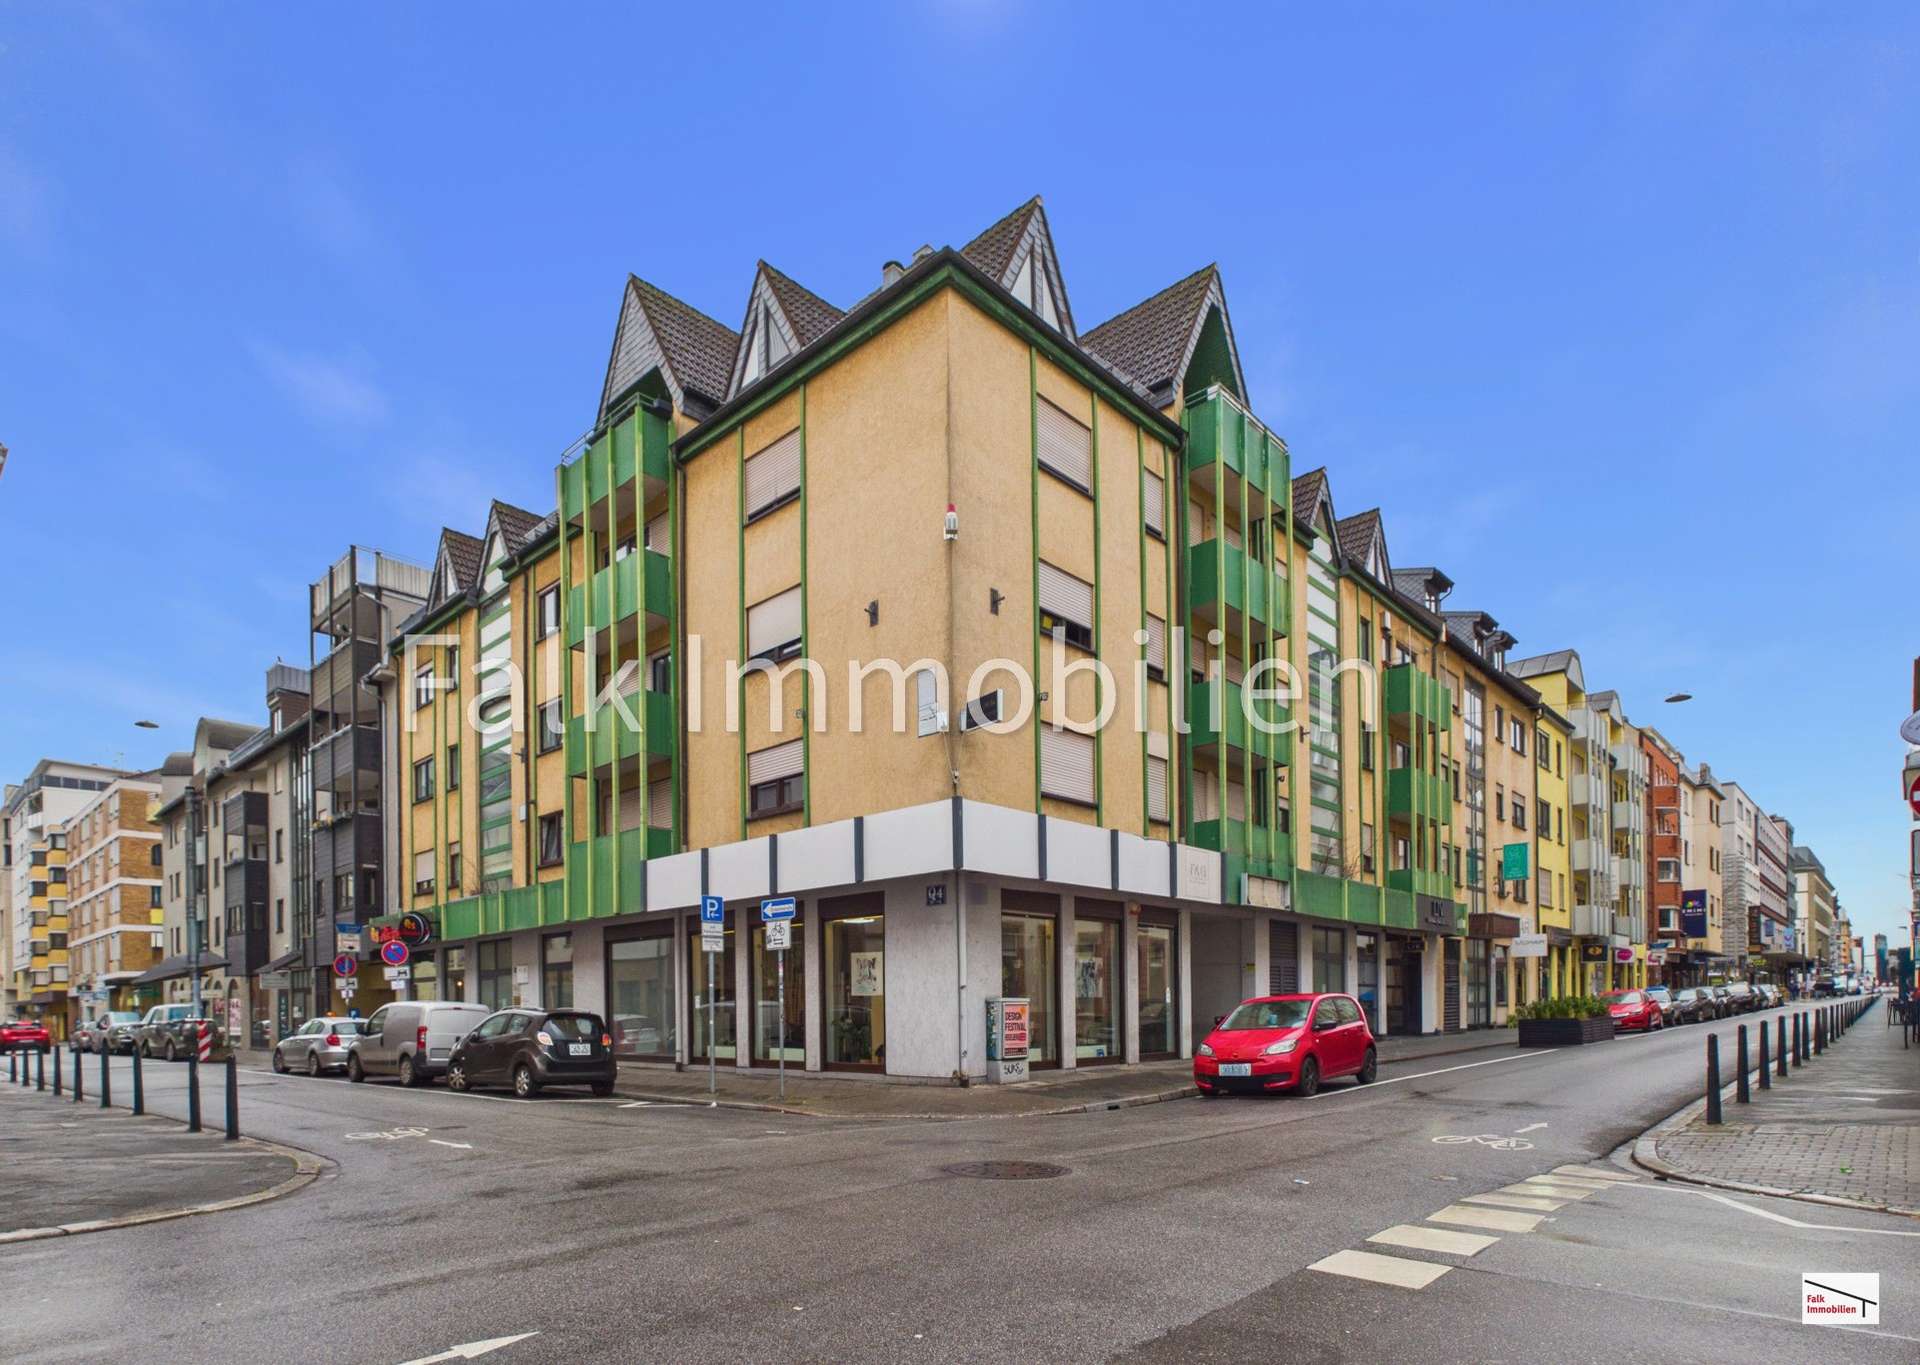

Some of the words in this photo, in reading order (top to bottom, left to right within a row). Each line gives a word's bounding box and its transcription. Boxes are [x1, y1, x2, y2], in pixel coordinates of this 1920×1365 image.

[707, 899, 719, 919] P
[1005, 1012, 1022, 1021] DESIGN
[1005, 1022, 1027, 1031] FESTIVAL
